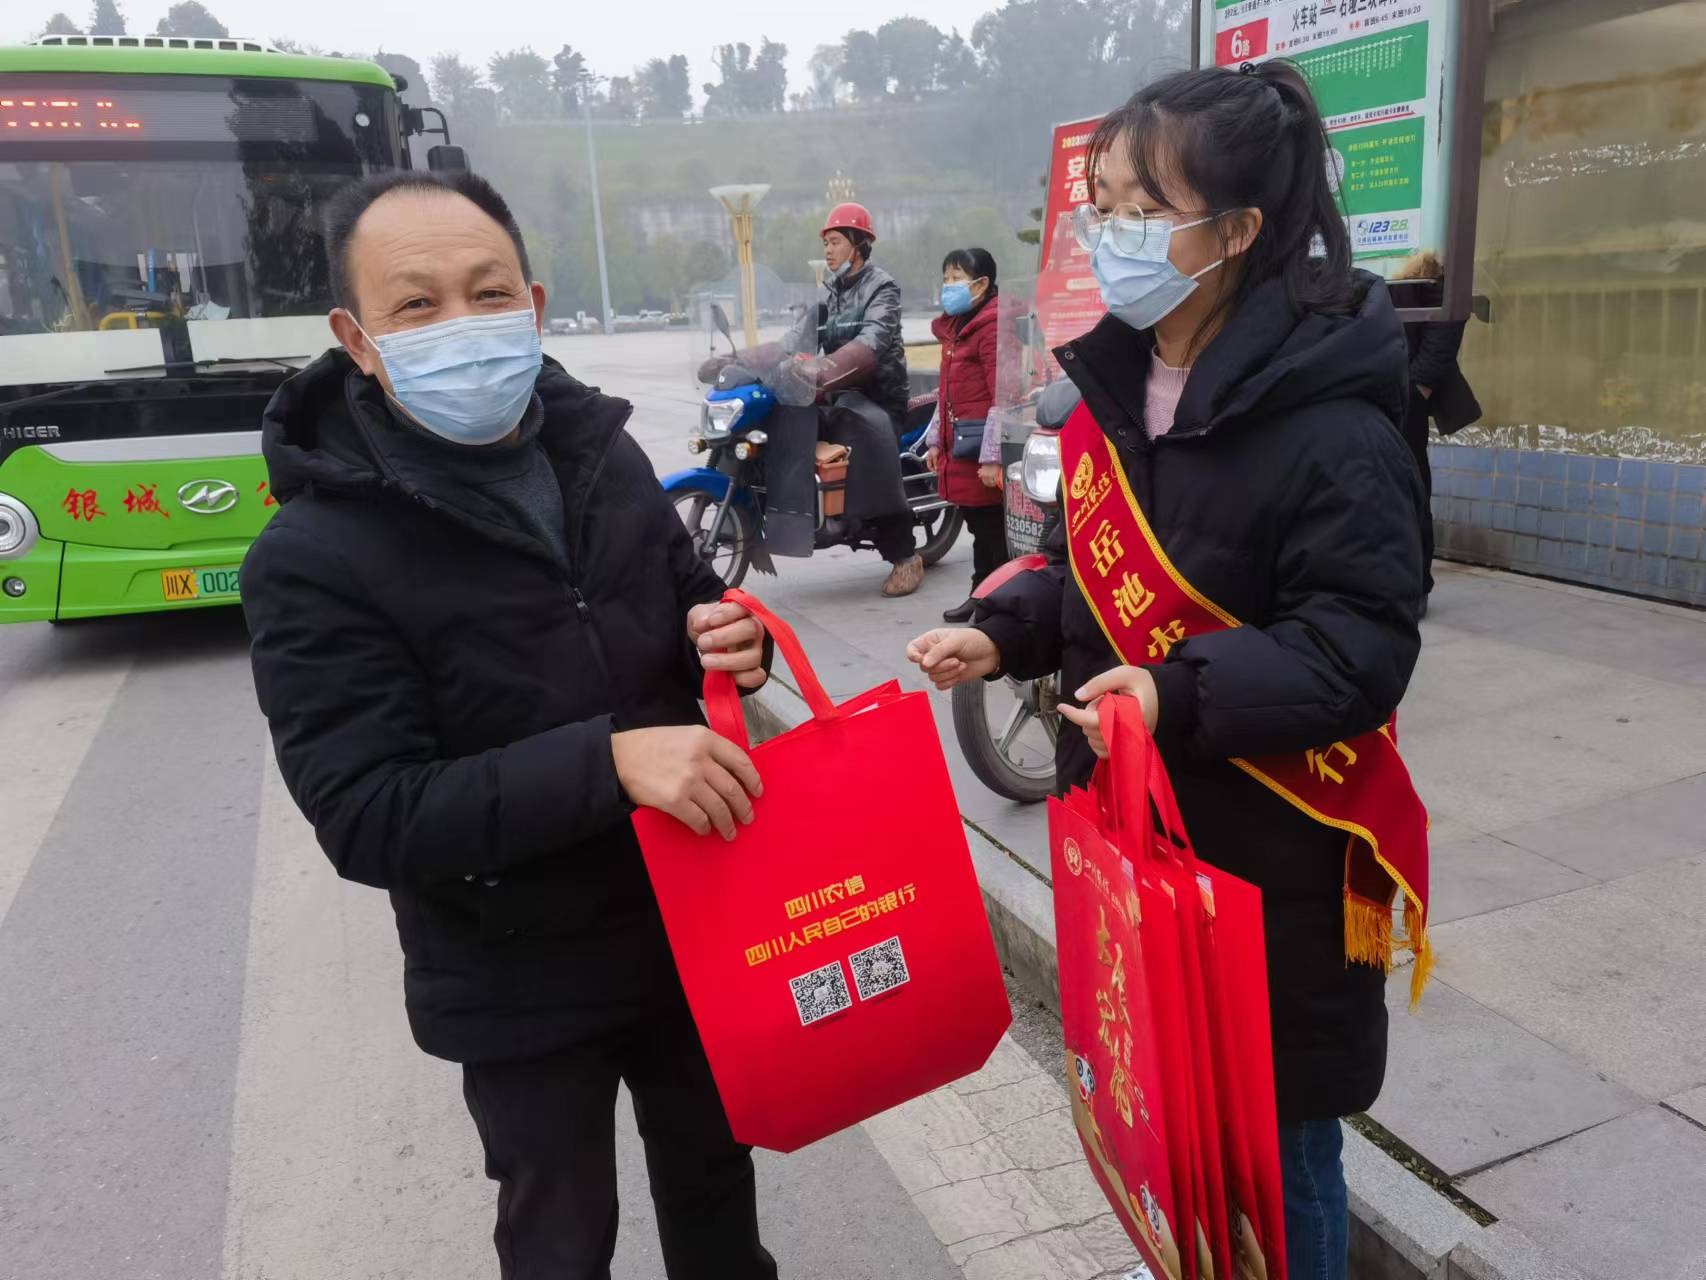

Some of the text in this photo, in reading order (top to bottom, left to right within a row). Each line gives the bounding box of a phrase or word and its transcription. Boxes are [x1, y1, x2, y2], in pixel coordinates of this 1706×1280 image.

[1292, 4, 1318, 32] 火车站
[1368, 219, 1408, 233] 12328
[3, 425, 61, 440] HIGER
[784, 875, 866, 920] 四川农信
[745, 883, 916, 967] 四川人民自己的银行
